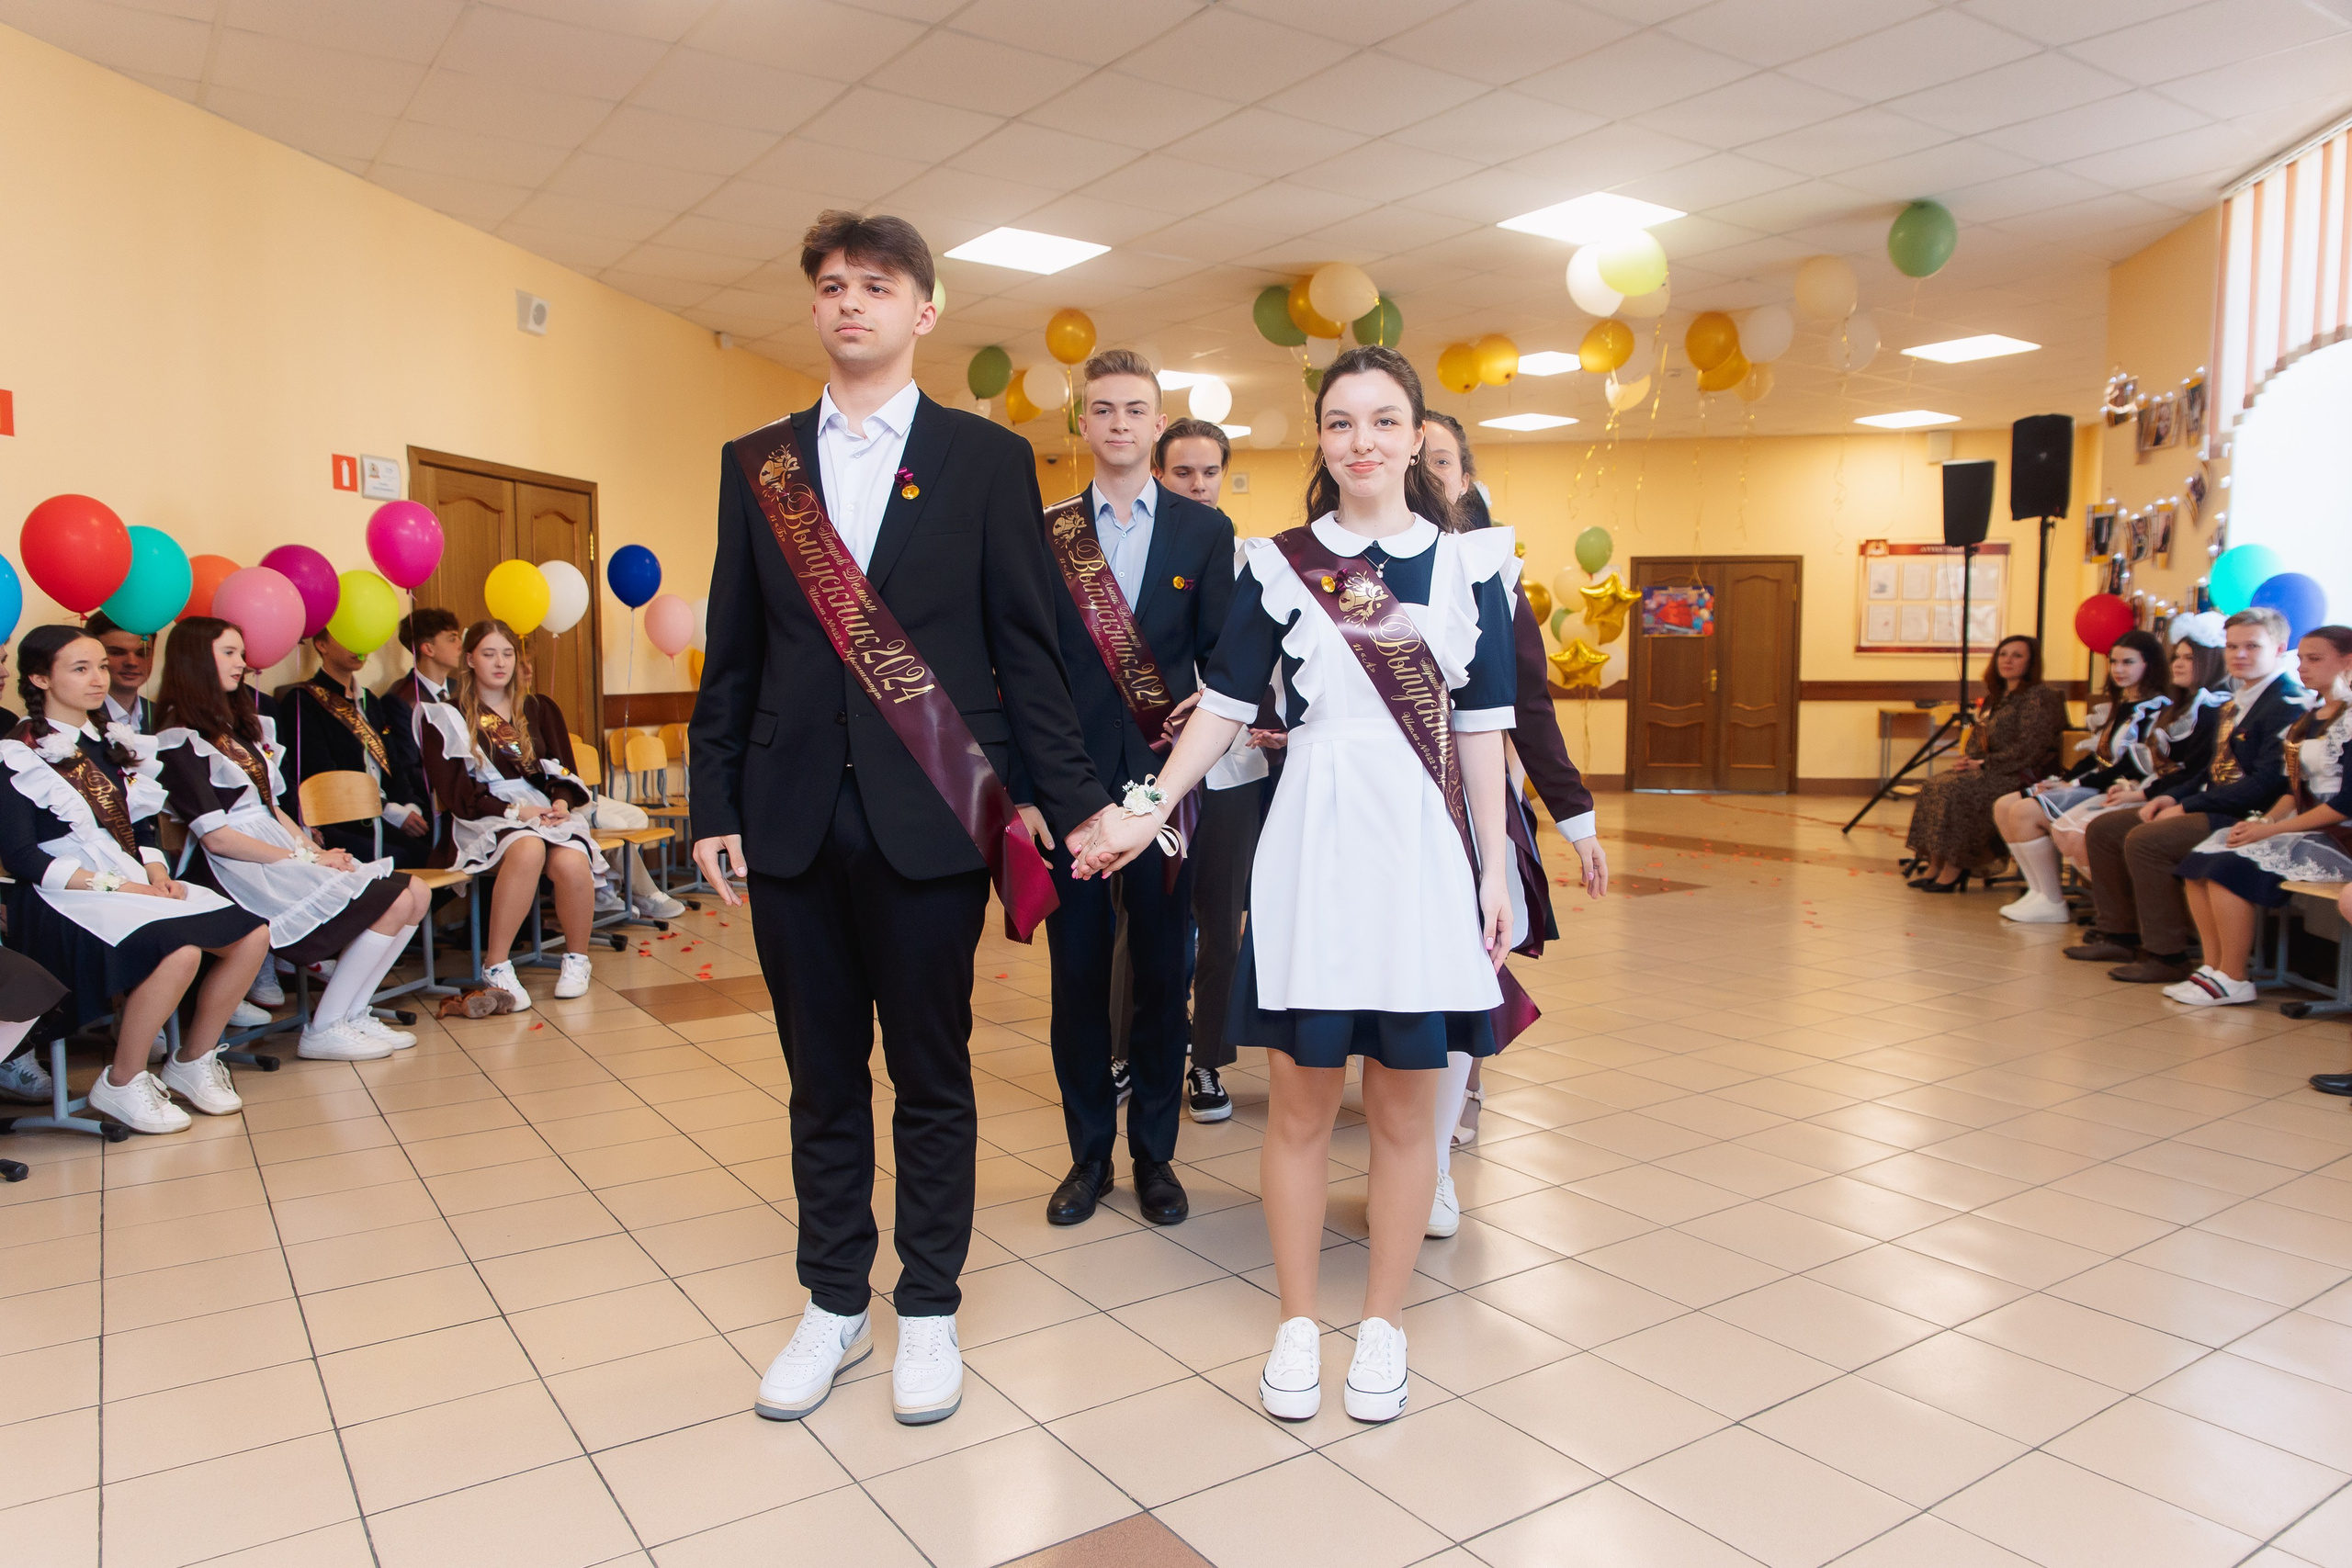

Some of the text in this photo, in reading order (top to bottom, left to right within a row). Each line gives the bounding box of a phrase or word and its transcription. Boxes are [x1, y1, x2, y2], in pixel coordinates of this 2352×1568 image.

[778, 483, 935, 704] Выпускник 2024
[818, 522, 877, 613] Петров Демьян
[1069, 538, 1170, 710] Выпускник 2024
[808, 585, 826, 615] Школа
[843, 647, 882, 700] Кронштадт
[1368, 614, 1454, 775] Выпускница
[1401, 711, 1420, 741] Школа
